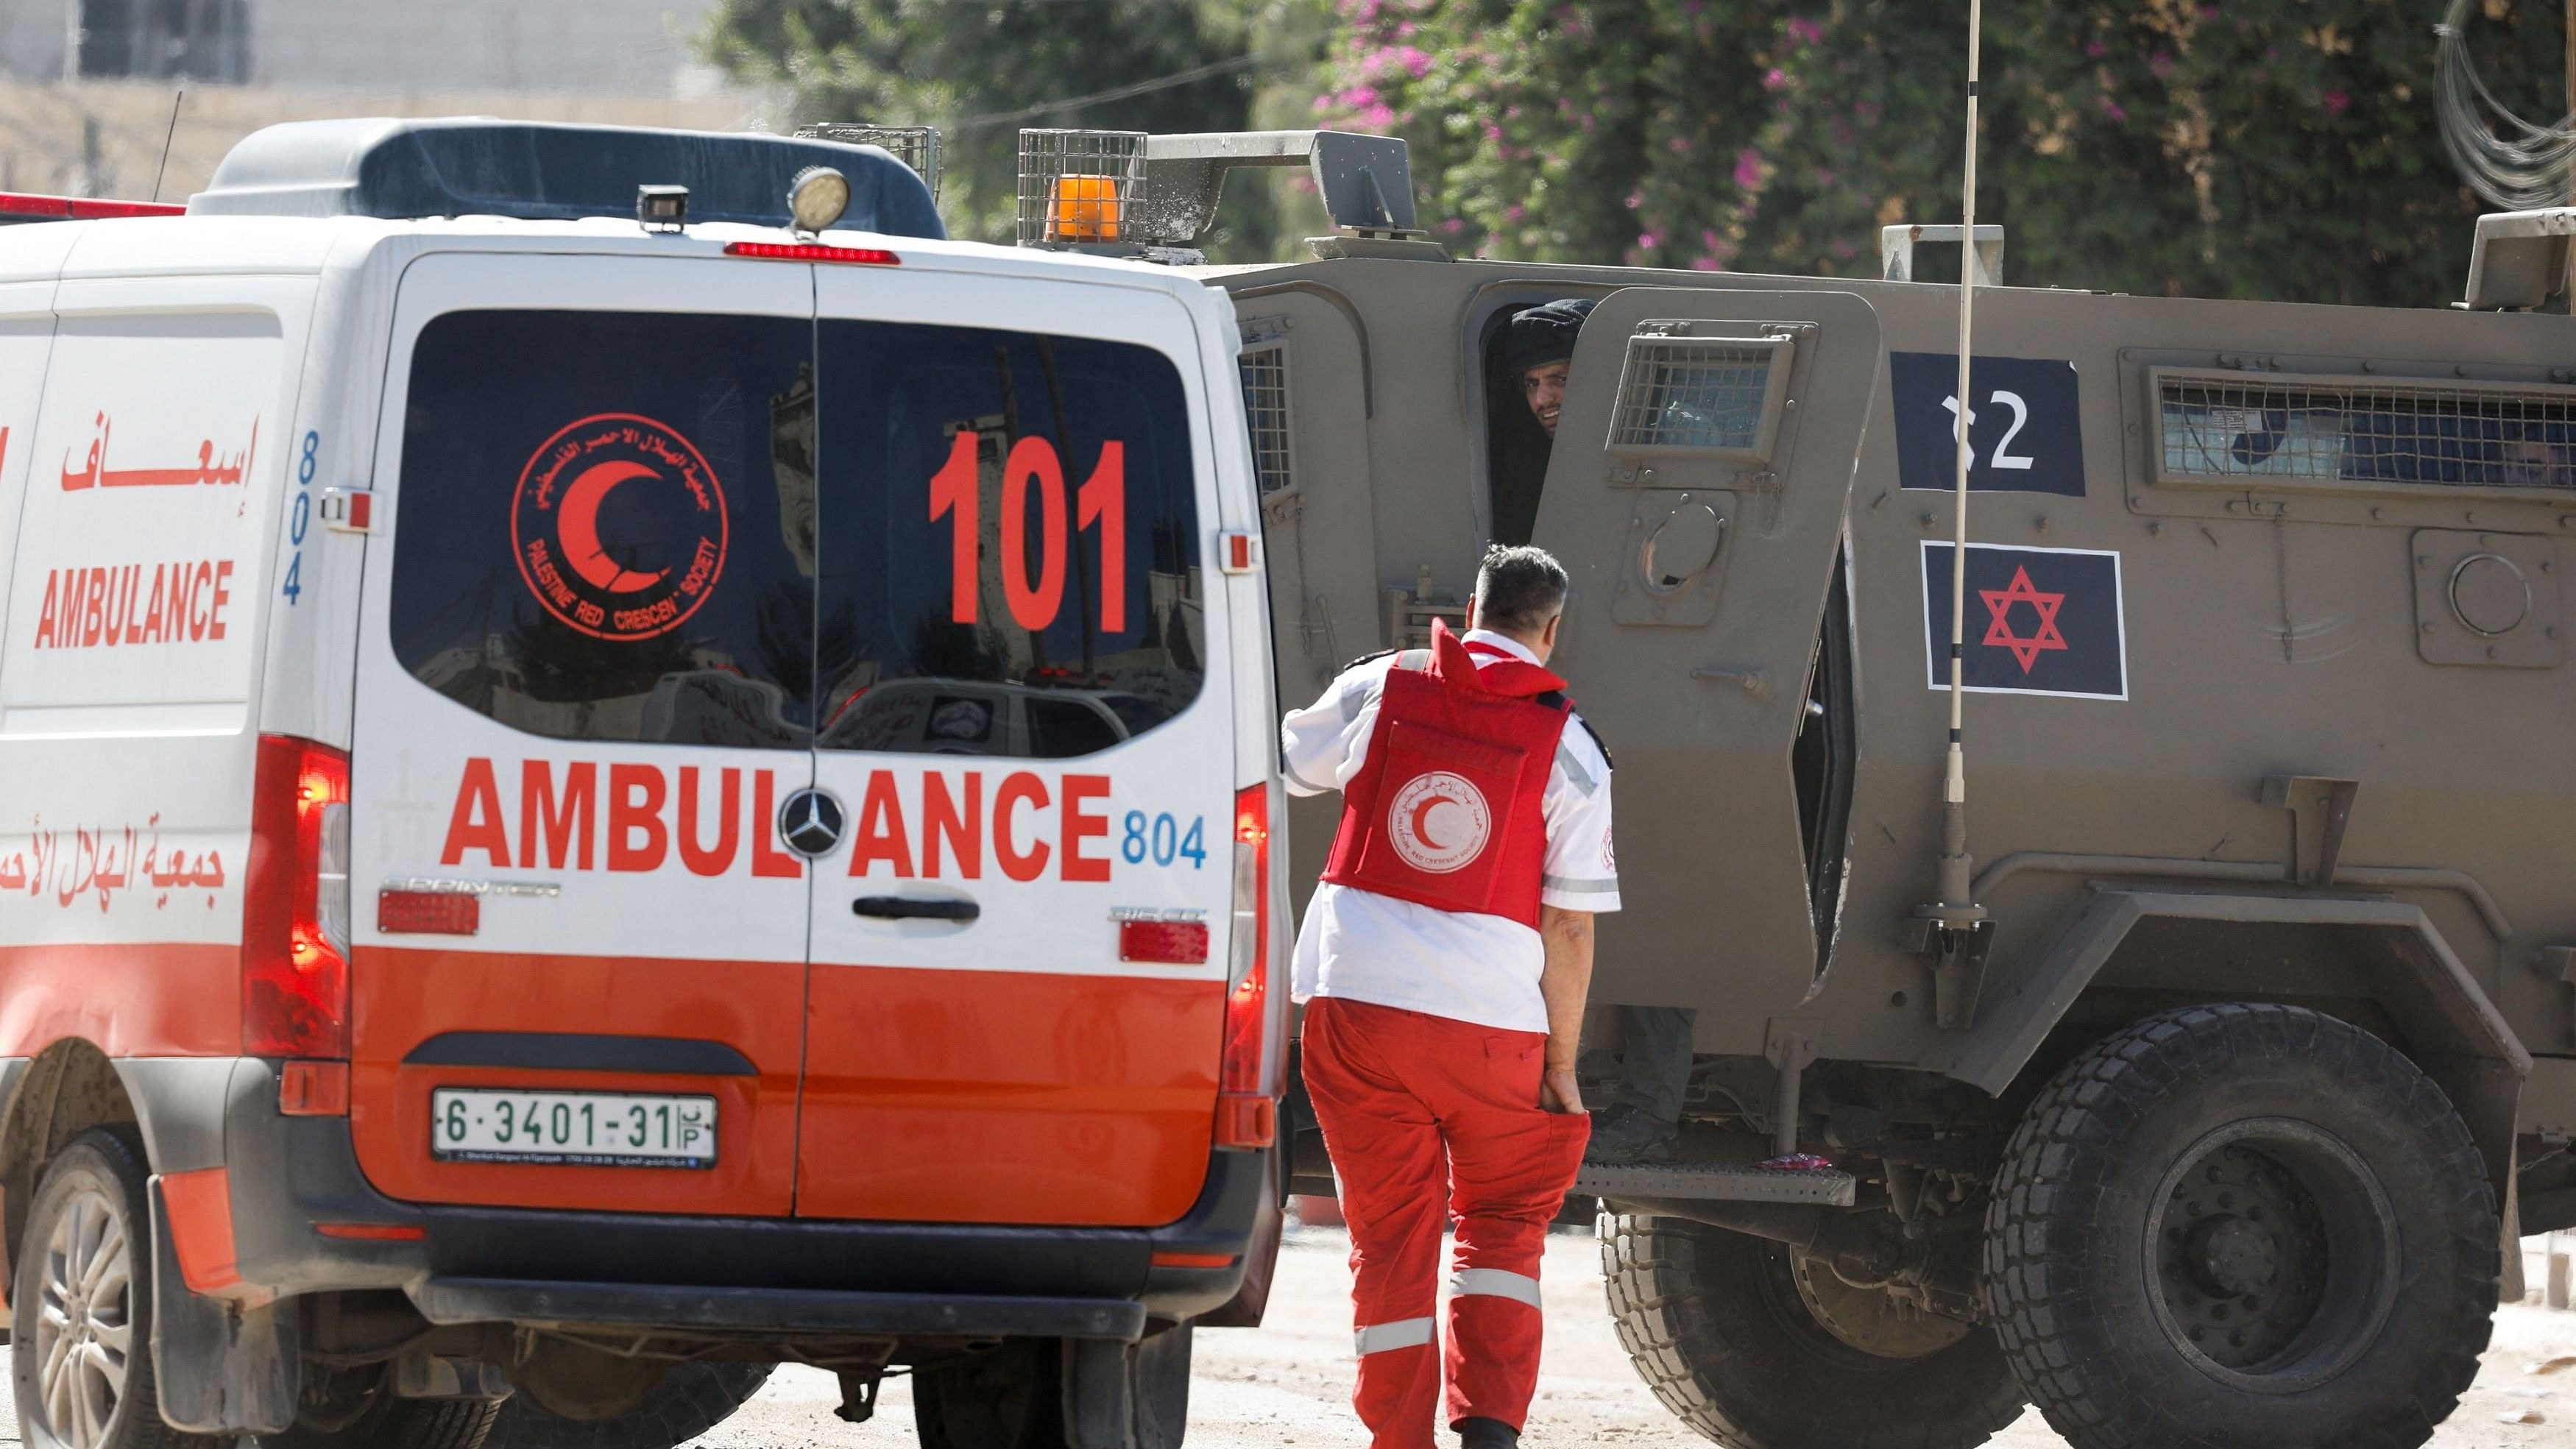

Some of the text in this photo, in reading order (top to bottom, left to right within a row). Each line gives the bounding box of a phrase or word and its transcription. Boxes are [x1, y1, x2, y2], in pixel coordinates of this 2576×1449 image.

[61, 409, 260, 517] إسعاف
[283, 430, 319, 606] 804
[929, 430, 1125, 633] 101
[35, 559, 234, 649] AMBULANCE
[527, 536, 718, 630] PALESTINE RED CRESCEN SOCIETY
[58, 822, 138, 913] الهلال
[142, 811, 224, 910] جمعية
[1122, 809, 1206, 870] 804
[1411, 850, 1423, 861] RED
[684, 1128, 699, 1150] P
